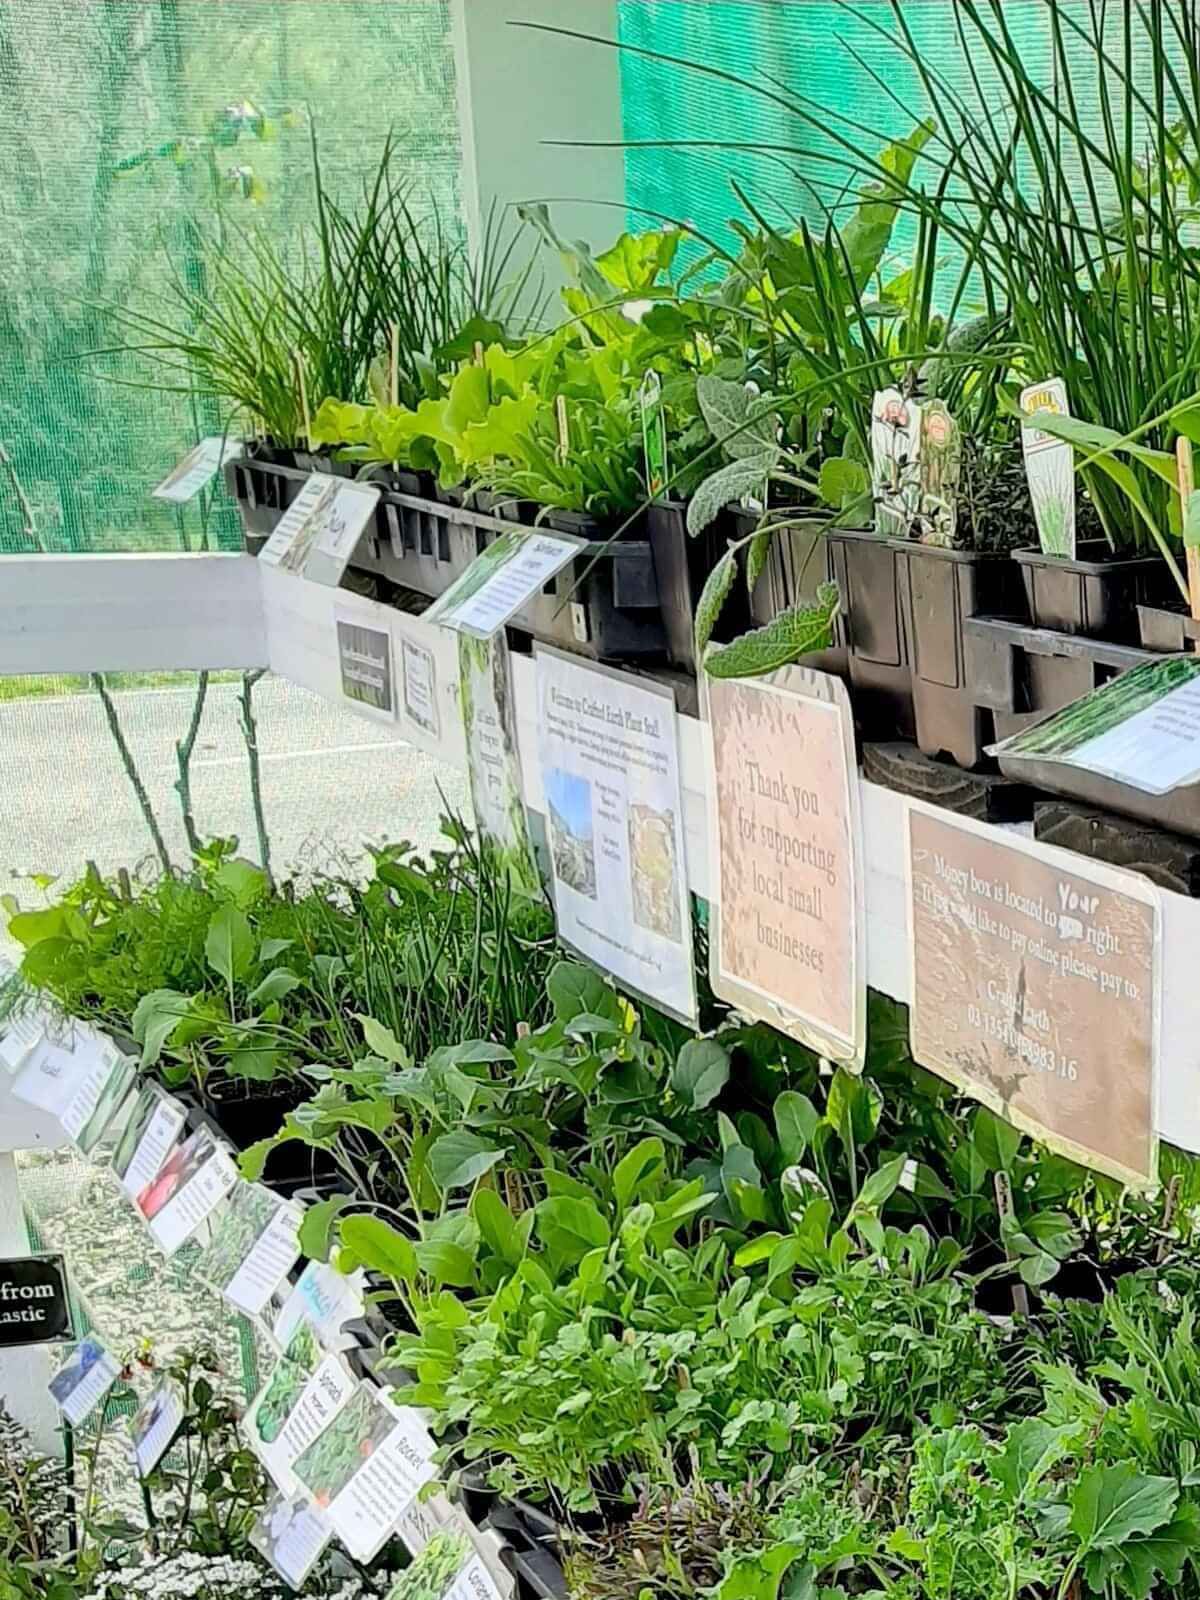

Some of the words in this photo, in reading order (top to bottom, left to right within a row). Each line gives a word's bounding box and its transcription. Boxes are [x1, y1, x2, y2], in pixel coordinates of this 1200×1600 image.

[746, 761, 789, 806] Thank
[792, 785, 819, 817] you
[738, 807, 757, 842] for
[760, 822, 837, 886] supporting
[752, 860, 784, 905] local
[788, 882, 823, 921] small
[933, 854, 968, 894] Money
[970, 868, 991, 898] box
[993, 879, 1002, 902] is
[1004, 881, 1043, 923] located
[1044, 906, 1057, 928] to
[1058, 881, 1099, 914] Your
[755, 911, 825, 974] businesses
[978, 906, 998, 934] like
[999, 919, 1010, 942] to
[1011, 929, 1027, 955] pay
[1027, 935, 1058, 967] online
[1061, 953, 1099, 983] please
[1101, 968, 1122, 998] pay
[1060, 1055, 1078, 1082] 16
[0, 1281, 56, 1300] from
[0, 1305, 46, 1323] astic
[395, 1436, 425, 1471] Rocket
